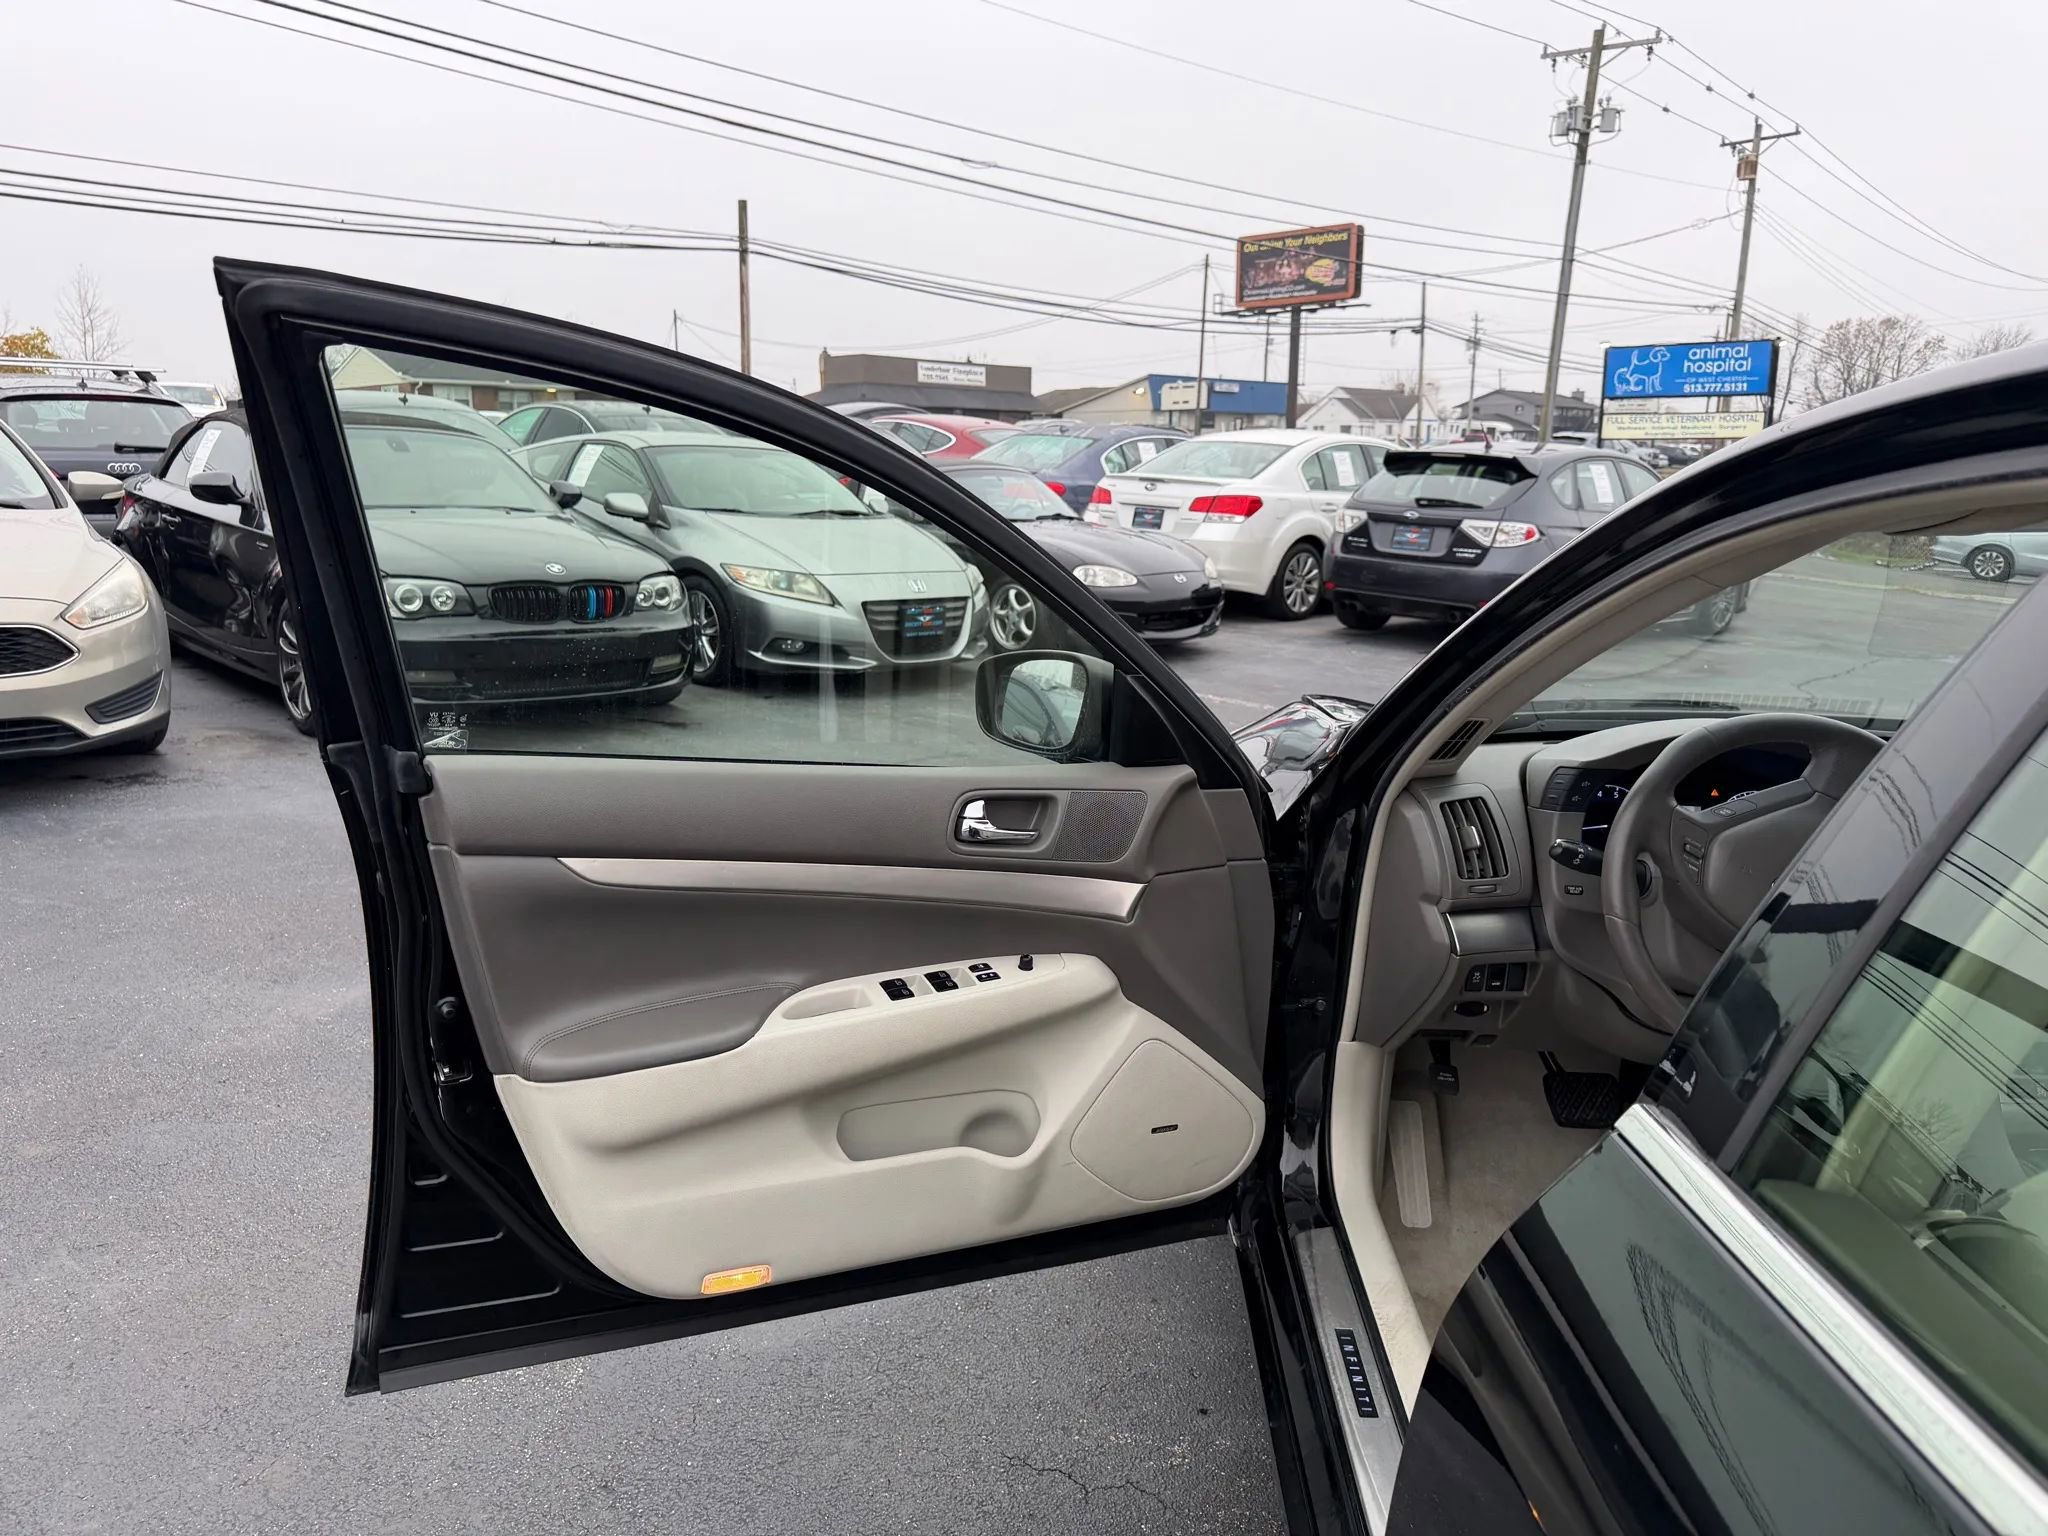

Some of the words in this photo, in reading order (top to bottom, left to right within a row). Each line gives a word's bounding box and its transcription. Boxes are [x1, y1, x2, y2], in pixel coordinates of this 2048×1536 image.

[1284, 237, 1303, 247] Your
[1304, 232, 1348, 245] Neighbors
[1688, 343, 1749, 360] animal
[1683, 357, 1752, 375] hospital
[1683, 382, 1748, 393] 513.777.5131
[1606, 416, 1628, 424] FULL
[1628, 416, 1662, 424] SERVICE
[1666, 415, 1715, 423] VETERINARY
[1719, 414, 1760, 423] HOSPITAL
[1614, 791, 1619, 799] 5
[1340, 1335, 1373, 1411] INFINITI
